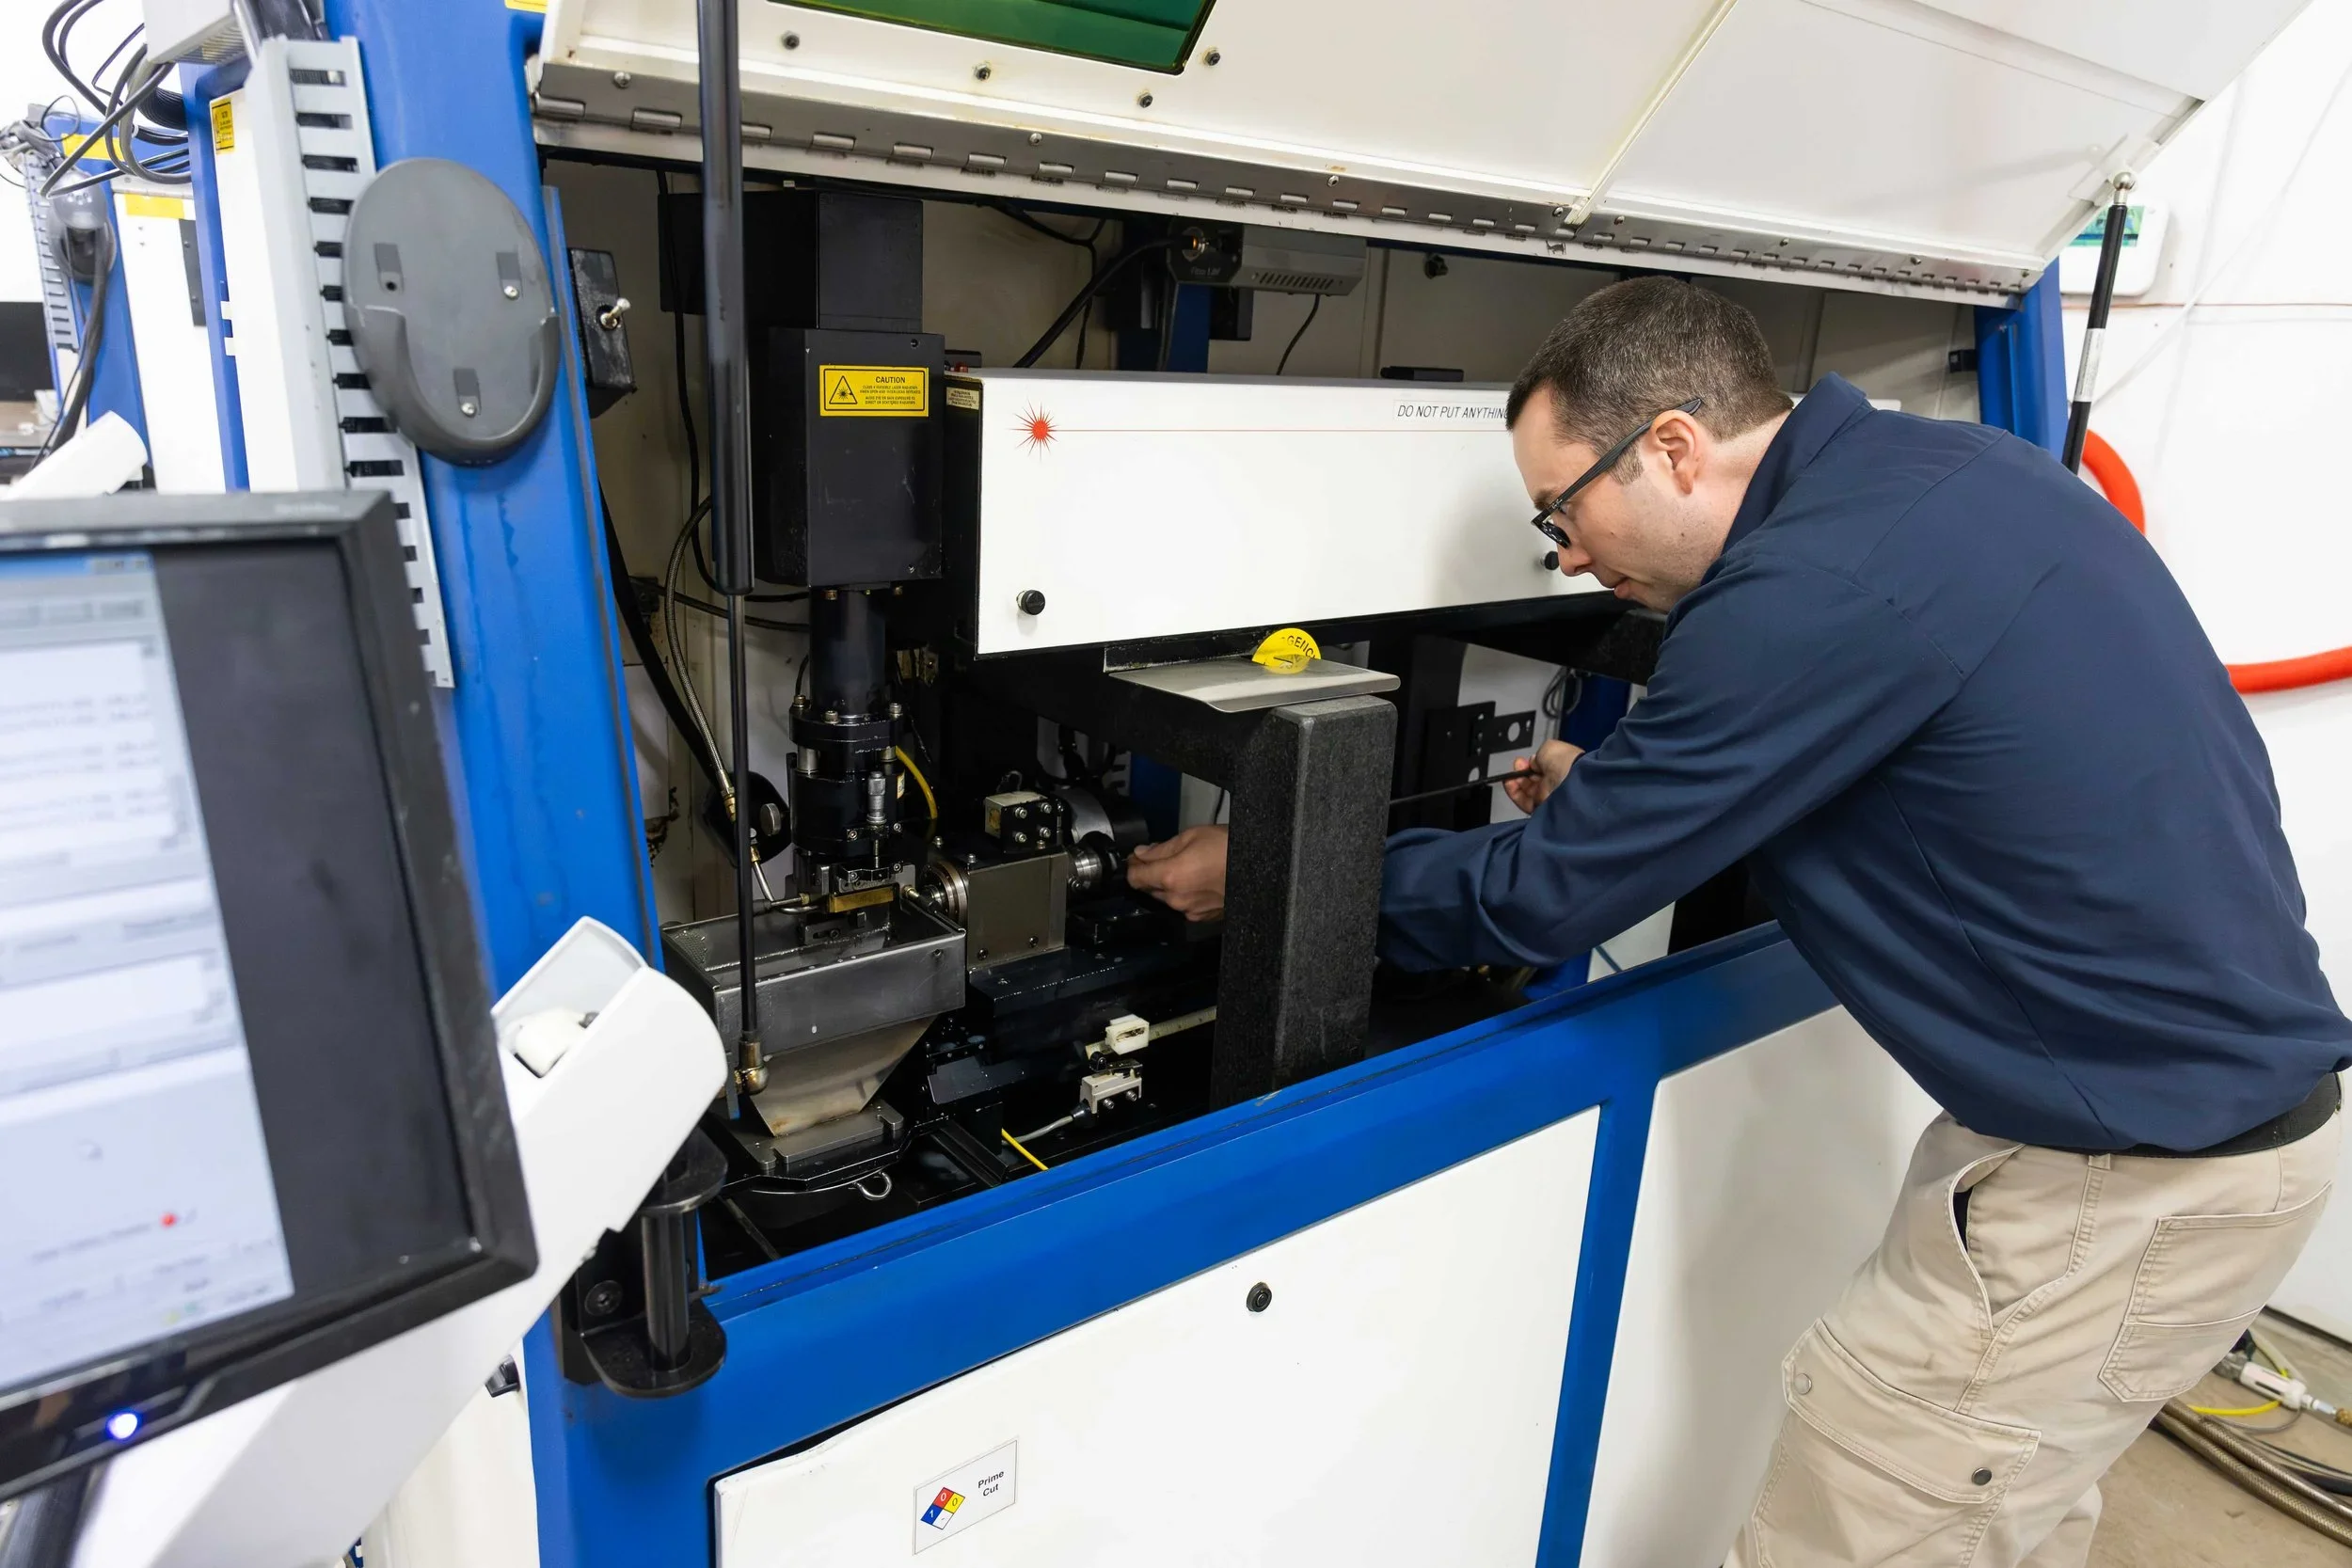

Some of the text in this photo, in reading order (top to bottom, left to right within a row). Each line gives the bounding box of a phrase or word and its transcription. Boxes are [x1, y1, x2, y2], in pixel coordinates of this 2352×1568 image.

[1397, 404, 1414, 418] DO
[1415, 405, 1439, 419] NOT
[1439, 406, 1461, 419] PUT
[977, 1471, 1004, 1488] Prime
[941, 1493, 946, 1501] 0
[982, 1483, 999, 1497] Cut
[952, 1497, 958, 1506] 0
